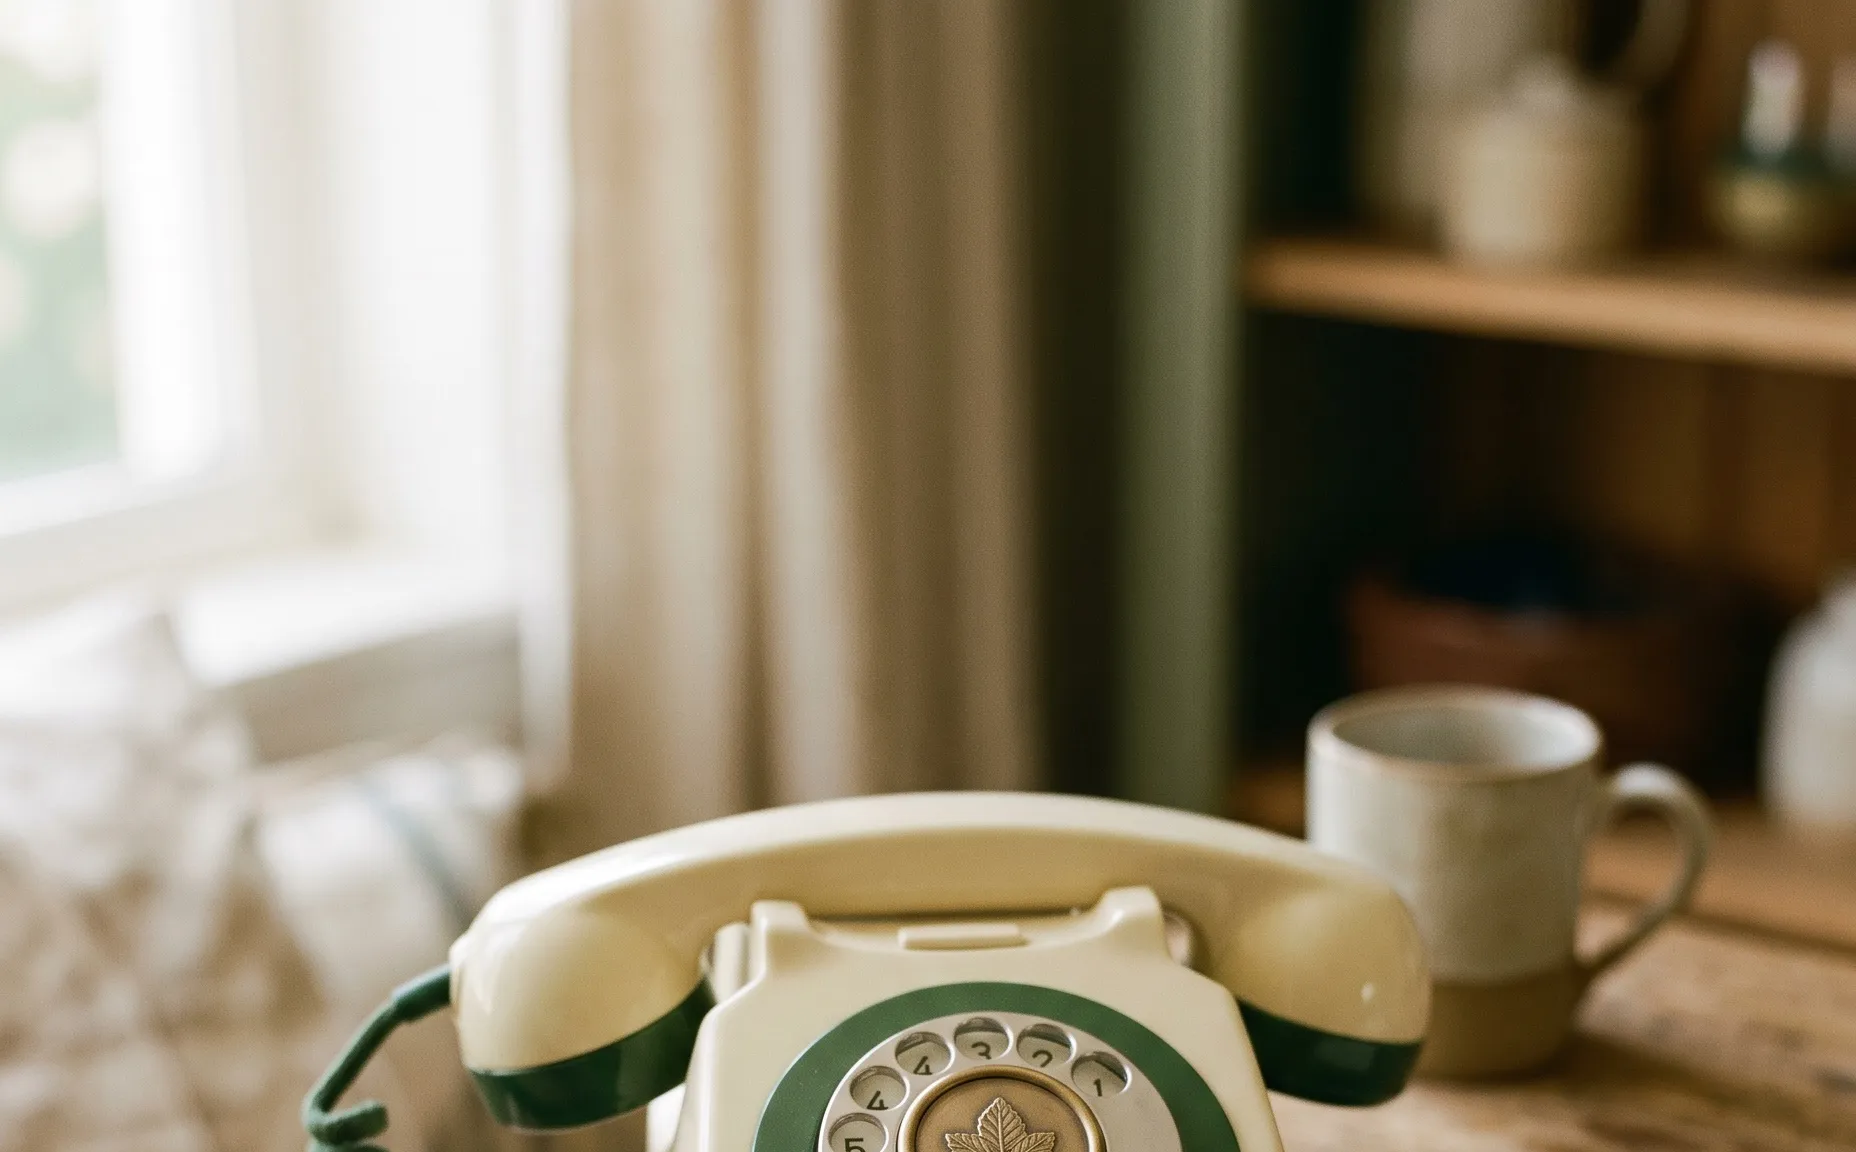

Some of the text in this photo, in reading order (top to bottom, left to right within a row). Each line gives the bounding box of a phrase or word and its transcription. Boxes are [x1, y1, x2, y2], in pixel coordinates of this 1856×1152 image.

[971, 1041, 992, 1060] 3
[912, 1056, 933, 1075] 4
[1093, 1078, 1103, 1097] 1
[866, 1090, 889, 1111] 4
